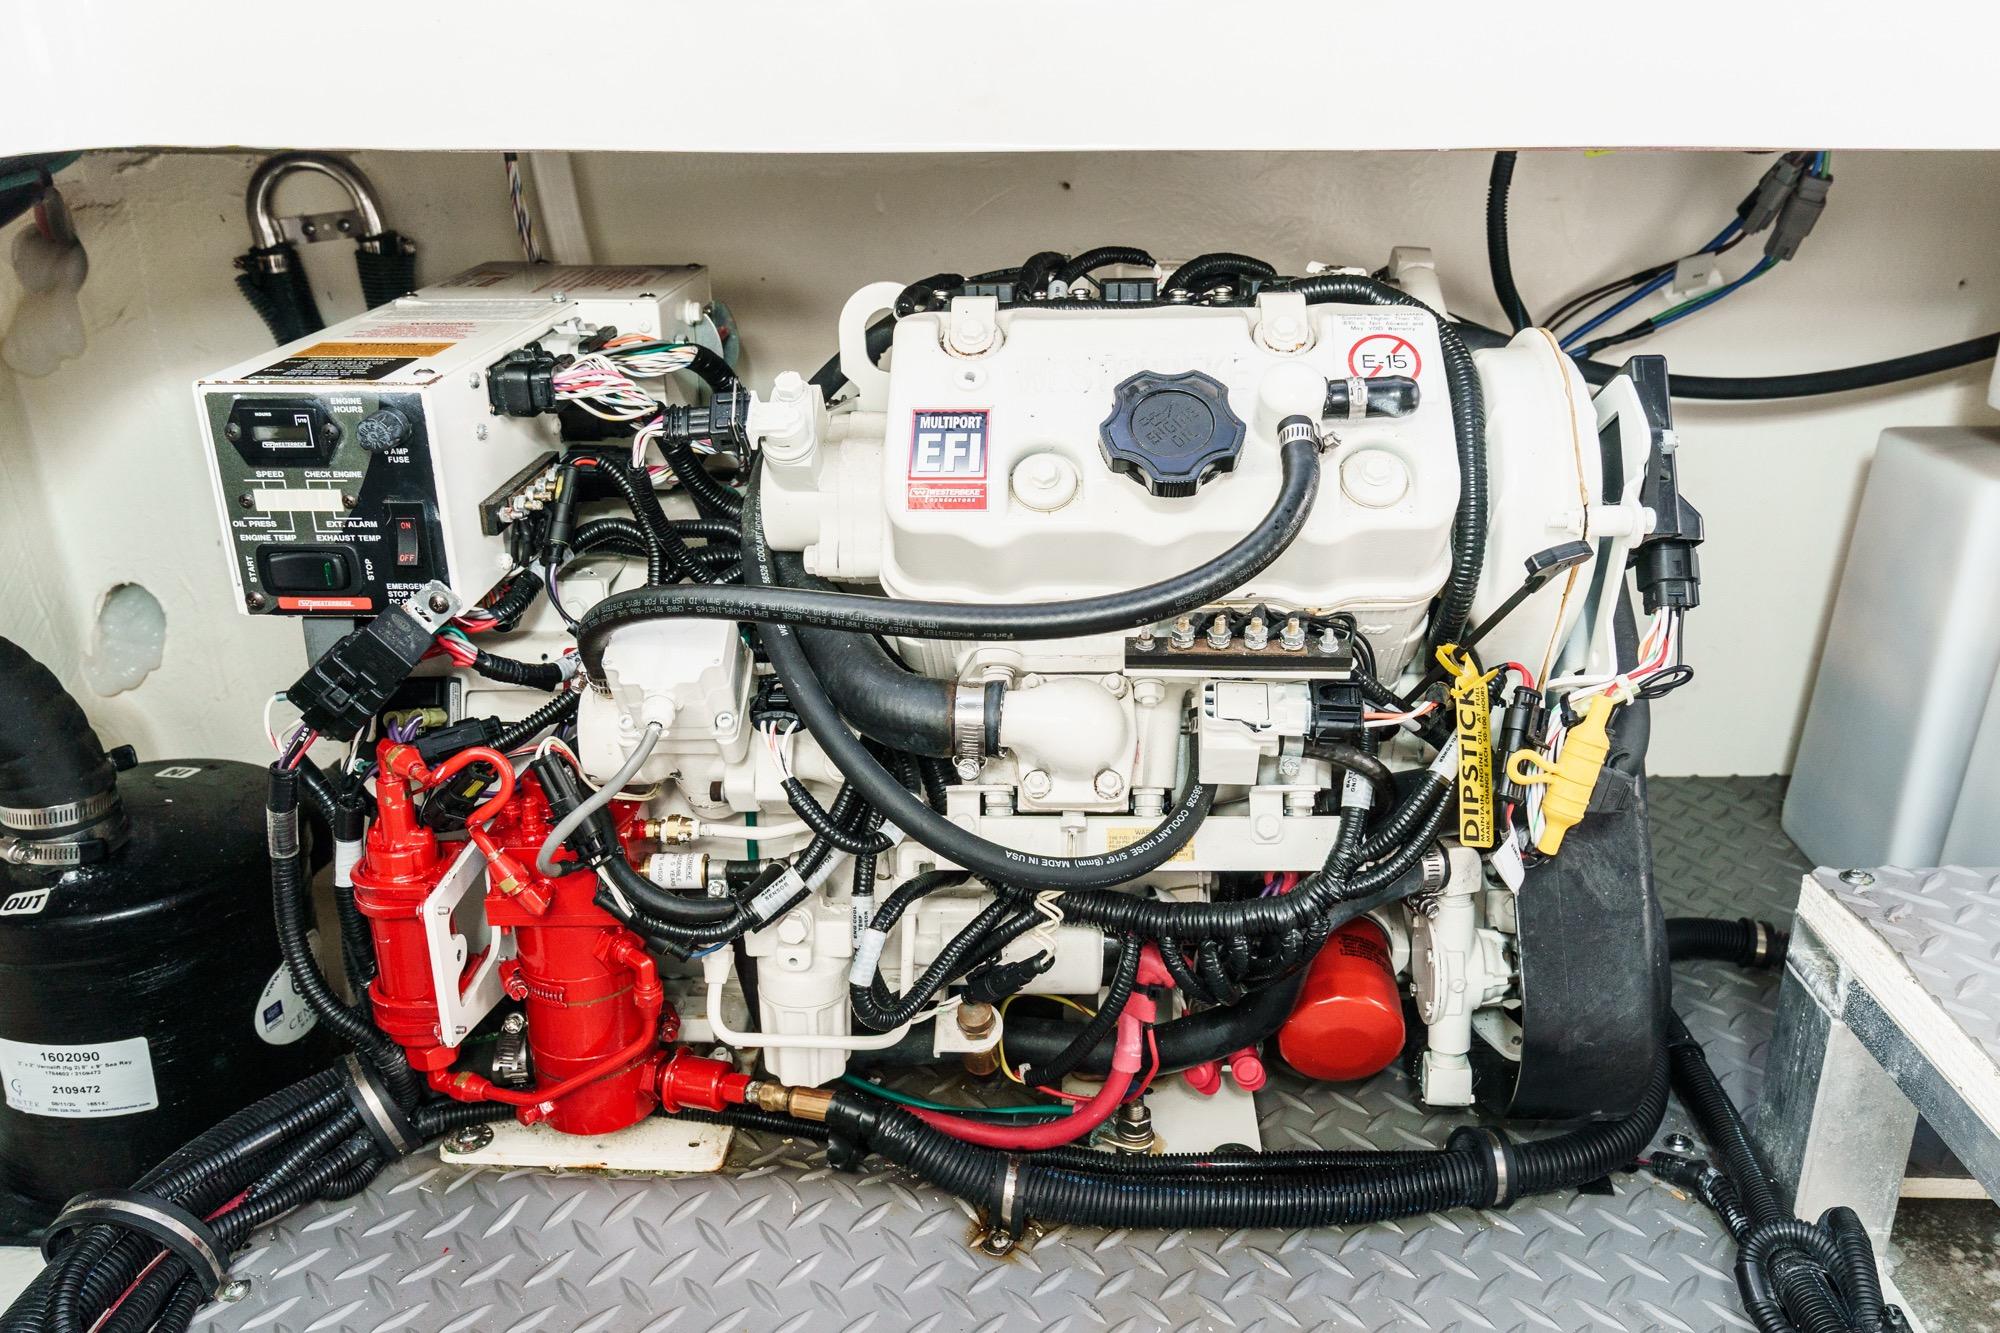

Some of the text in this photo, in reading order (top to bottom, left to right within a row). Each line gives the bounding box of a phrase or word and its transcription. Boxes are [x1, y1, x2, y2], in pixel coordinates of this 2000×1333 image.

[1362, 354, 1408, 369] E-15
[920, 416, 983, 429] MULTIPORT
[1171, 432, 1200, 448] OIL
[916, 432, 982, 473] EFI
[755, 529, 766, 563] COOLANT
[246, 556, 257, 583] START
[364, 558, 375, 581] STOP
[644, 597, 657, 605] FOR
[672, 597, 687, 605] USA
[754, 610, 769, 618] EPA
[760, 602, 810, 615] COMPATIBLE
[782, 612, 802, 621] HOSE
[809, 615, 826, 624] FUEL
[850, 613, 890, 624] ACCEPTED
[830, 618, 861, 629] MARINE
[864, 622, 886, 631] 7165
[894, 618, 914, 627] TYPE
[889, 624, 919, 635] SERIES
[981, 631, 1016, 640] Parker
[1477, 714, 1482, 724] AT
[1439, 744, 1452, 763] POWER
[1459, 688, 1480, 842] DIPSTICK
[166, 768, 192, 777] IN
[1186, 784, 1203, 808] 56526
[1152, 810, 1190, 844] COOLANT
[1132, 839, 1158, 858] HOSE
[1006, 850, 1027, 864] USA
[1028, 856, 1039, 865] IN
[1075, 857, 1104, 868] (8mm)
[1041, 858, 1070, 868] MADE
[772, 876, 787, 888] TEMP
[764, 882, 790, 901] SENSOR
[4, 894, 46, 911] OUT
[40, 1051, 100, 1062] 1602090
[52, 1085, 100, 1094] 2109472
